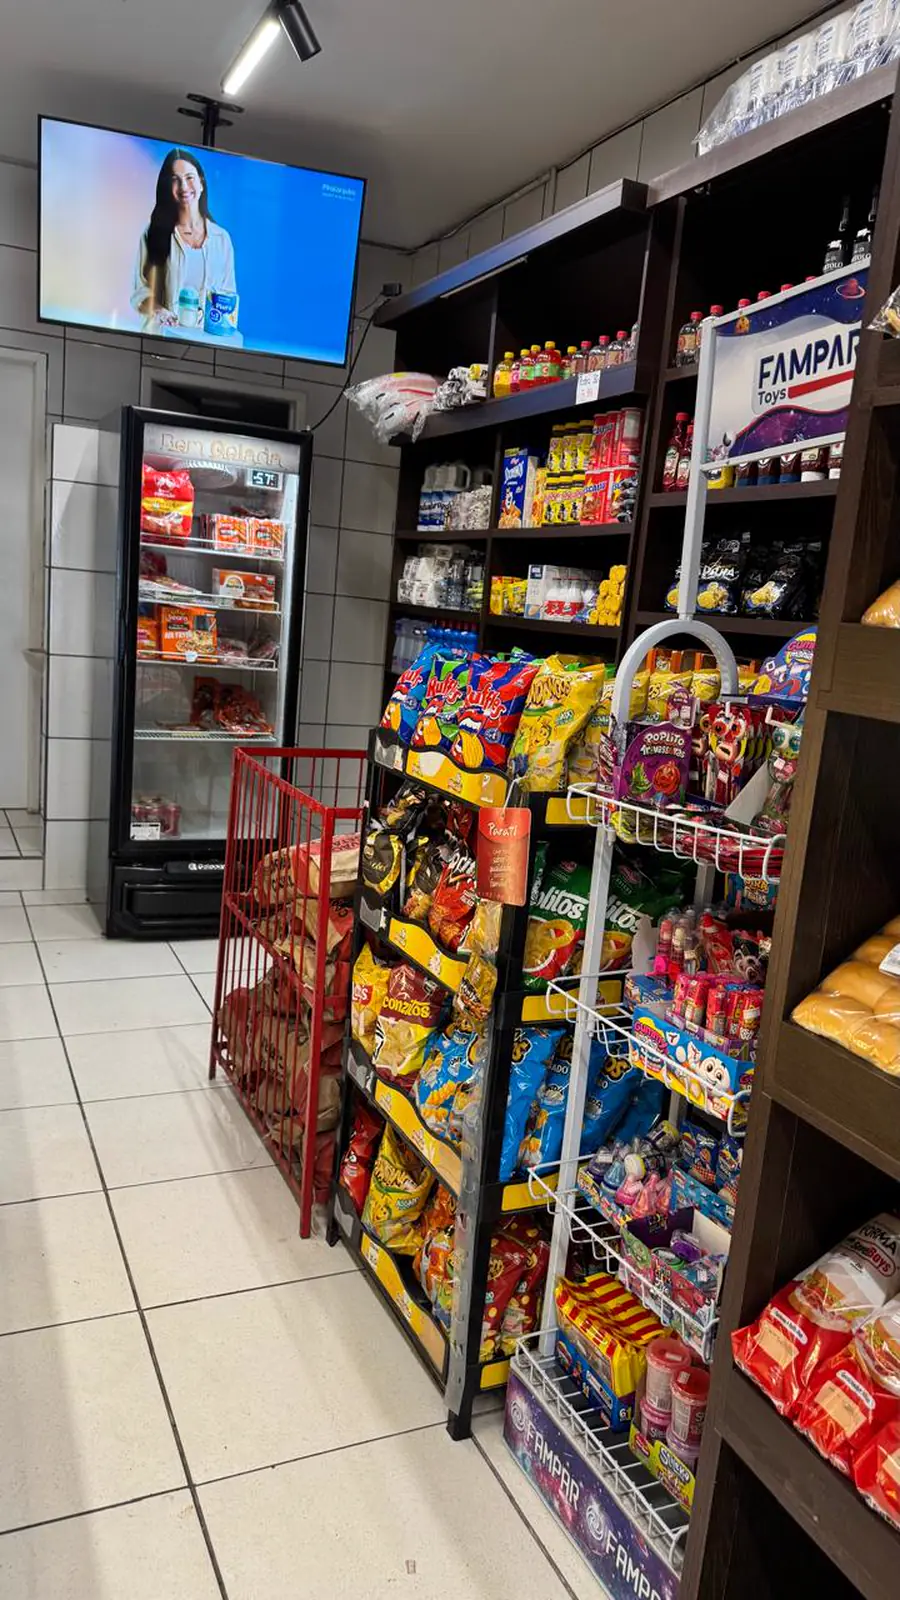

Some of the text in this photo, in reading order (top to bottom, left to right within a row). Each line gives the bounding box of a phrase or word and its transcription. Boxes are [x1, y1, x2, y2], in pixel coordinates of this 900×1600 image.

[758, 388, 787, 405] Toys
[382, 995, 431, 1019] conzitos
[526, 1419, 580, 1510] FAMPAR
